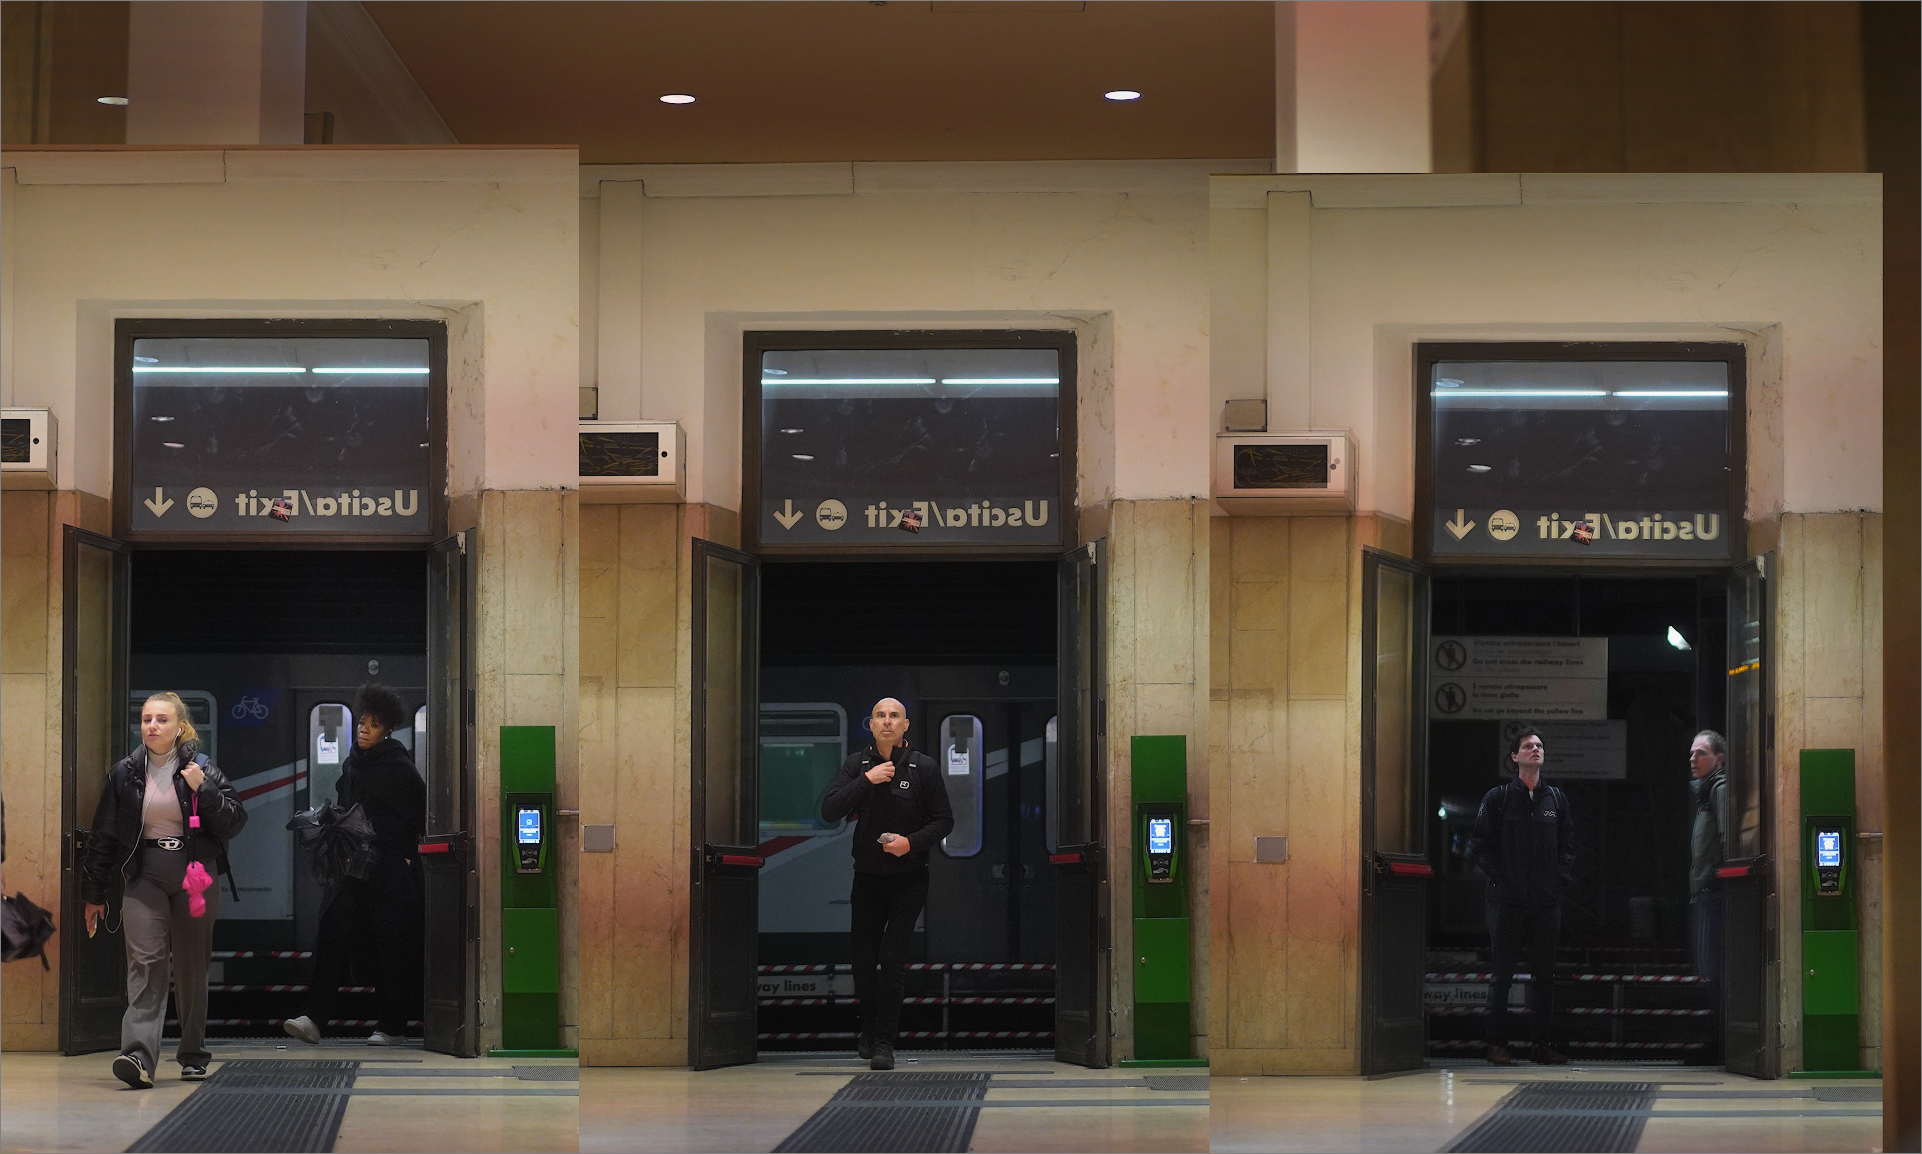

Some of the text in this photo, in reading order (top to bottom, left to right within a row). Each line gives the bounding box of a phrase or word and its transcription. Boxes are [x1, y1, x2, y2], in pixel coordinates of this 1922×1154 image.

[1534, 658, 1563, 667] railway
[784, 980, 817, 992] lines
[1455, 987, 1487, 999] lines
